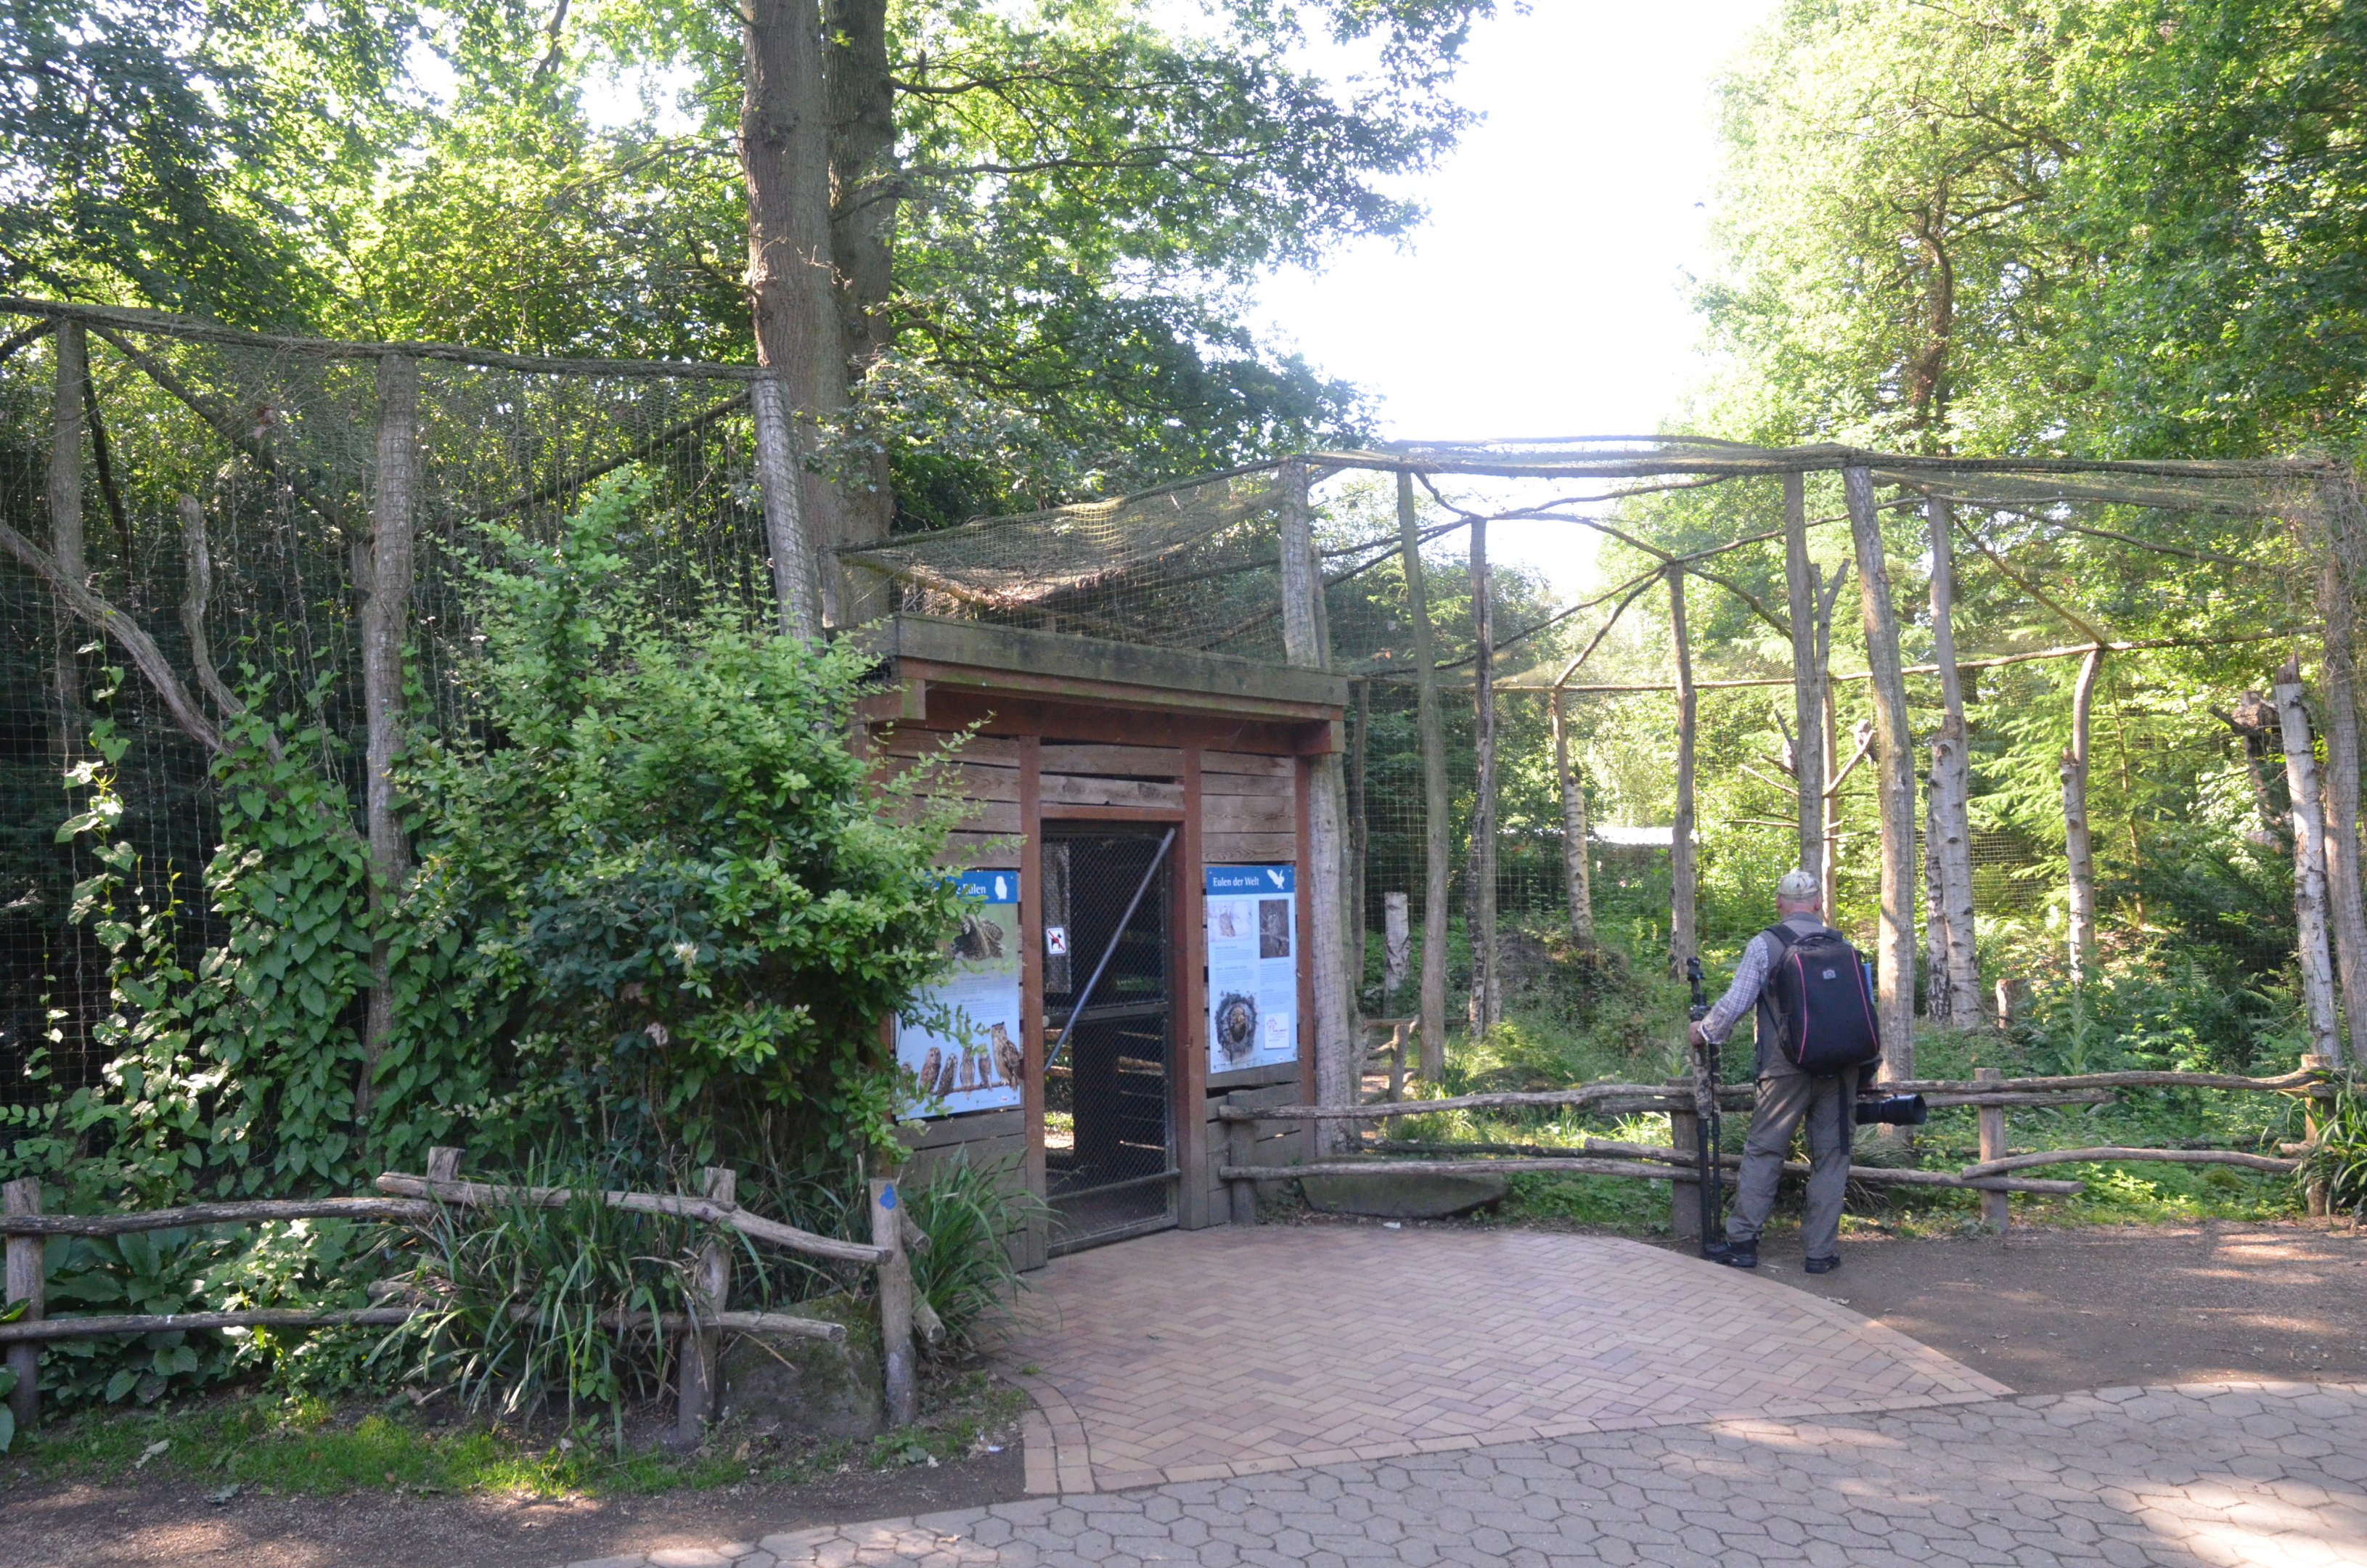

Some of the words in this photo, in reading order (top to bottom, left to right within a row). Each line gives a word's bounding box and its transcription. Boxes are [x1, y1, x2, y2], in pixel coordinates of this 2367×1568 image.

[1213, 877, 1232, 886] Eulen
[1232, 877, 1243, 886] der
[1244, 876, 1259, 886] Welt
